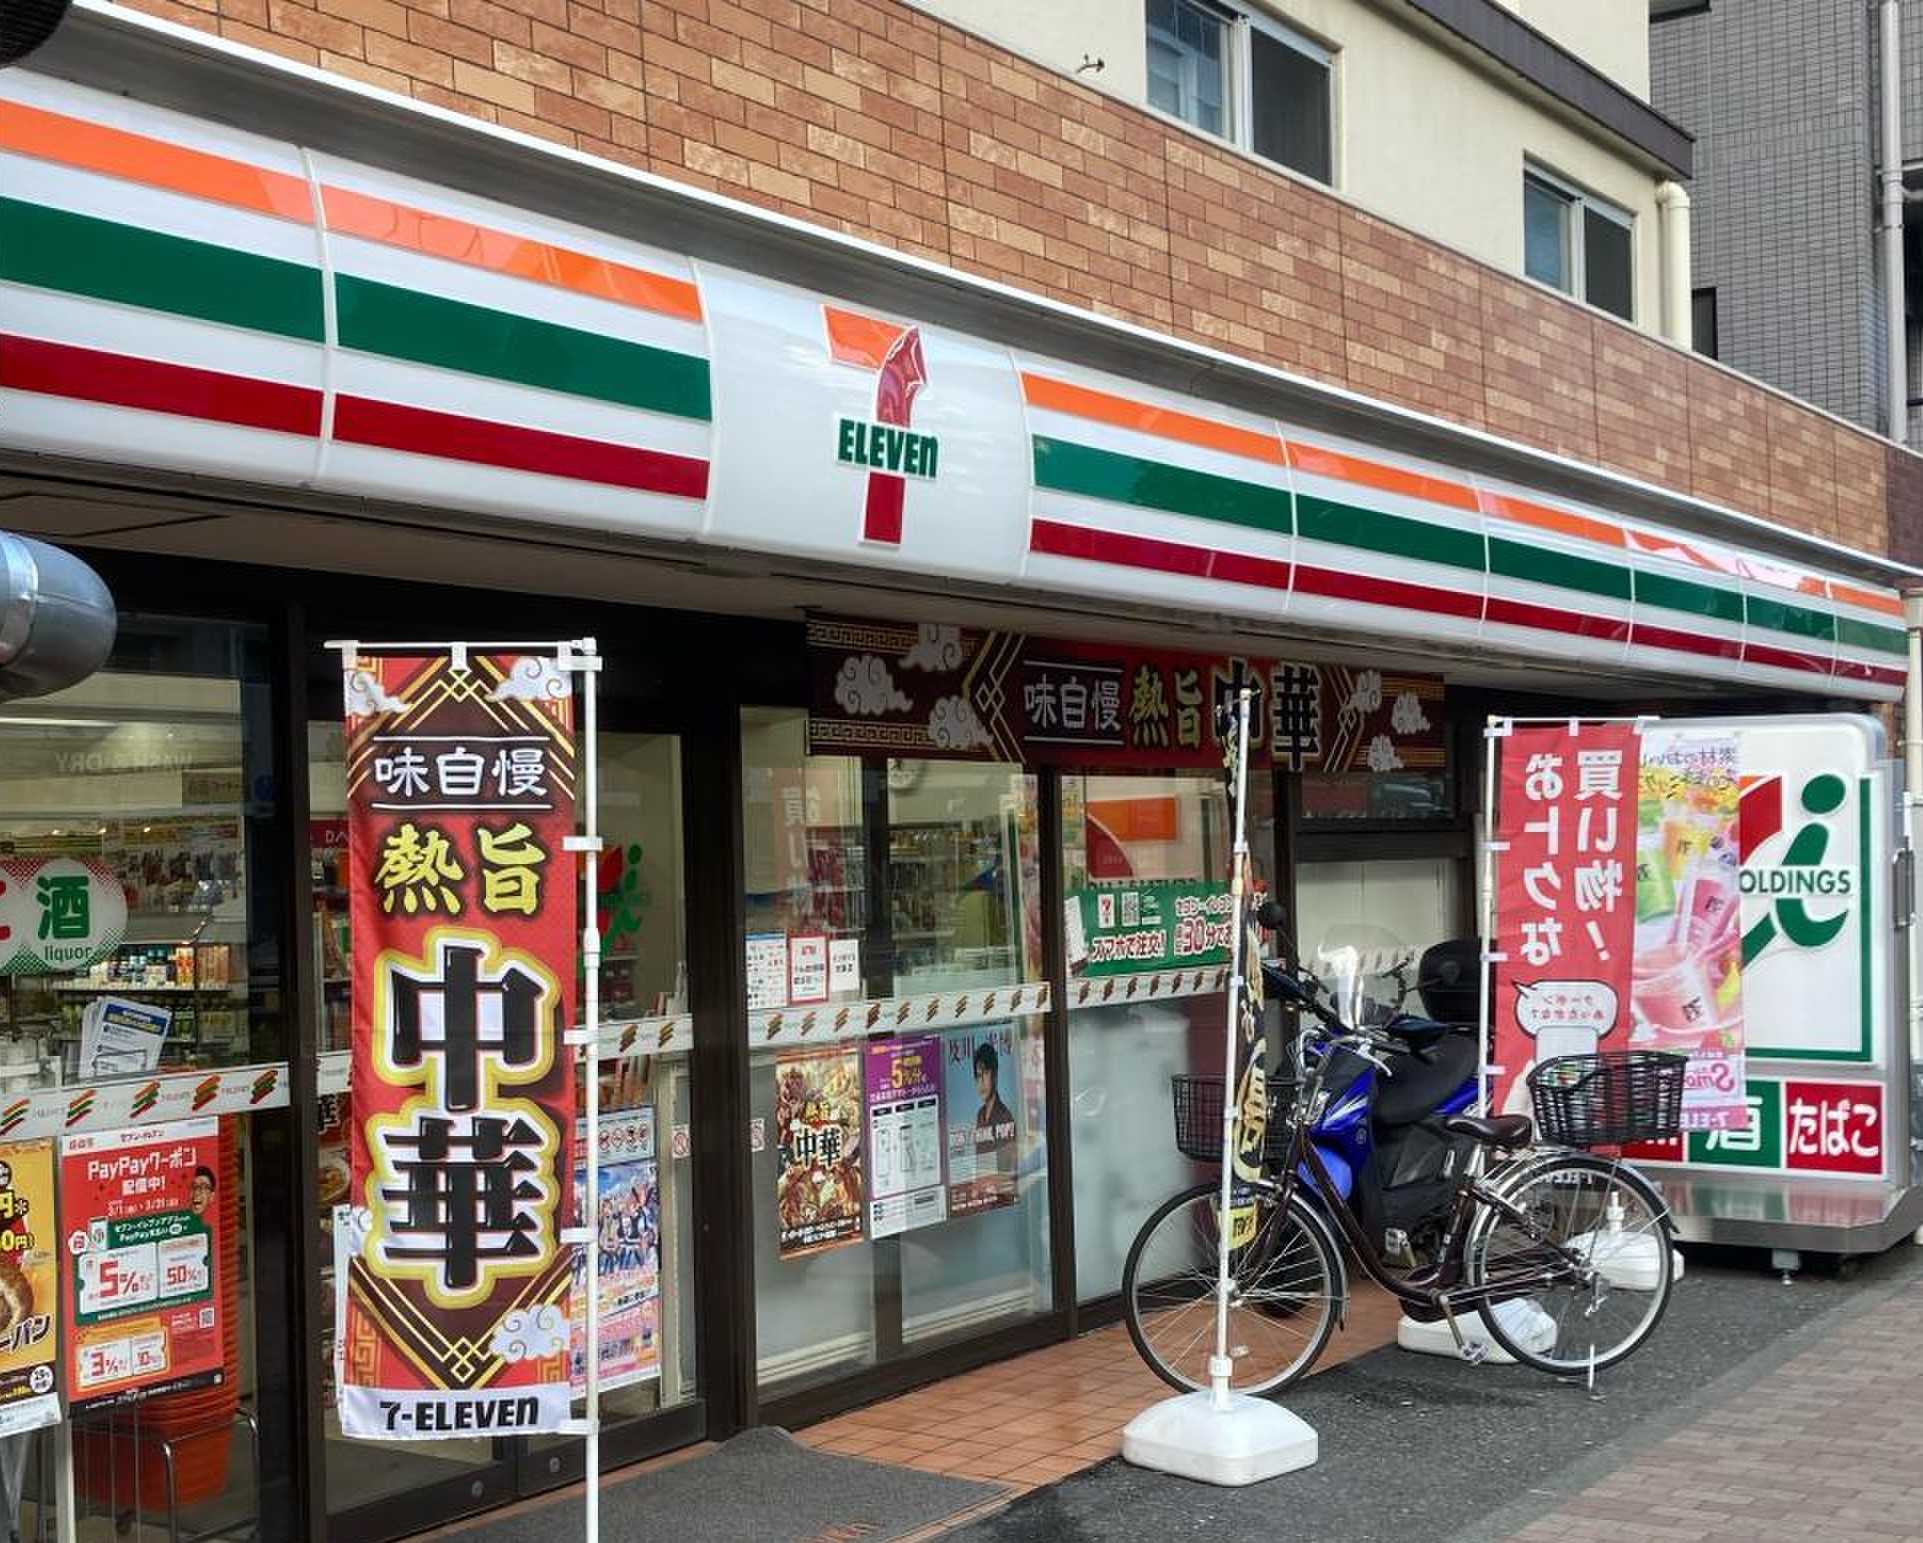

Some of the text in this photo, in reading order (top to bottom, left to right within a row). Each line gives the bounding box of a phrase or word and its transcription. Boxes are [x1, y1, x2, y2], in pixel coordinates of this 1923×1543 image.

[838, 418, 939, 479] ELEVEN
[1024, 673, 1123, 732] 味自慢
[374, 747, 549, 797] 味自慢
[374, 822, 547, 915] 熱旨
[1740, 869, 1851, 894] OLDINGS
[37, 875, 90, 940] 酒
[45, 945, 92, 962] liquor
[381, 943, 546, 1290] 中華
[1790, 1097, 1879, 1158] たばこ
[796, 1126, 840, 1167] 中華
[379, 1393, 540, 1433] 7-ELEVEN
